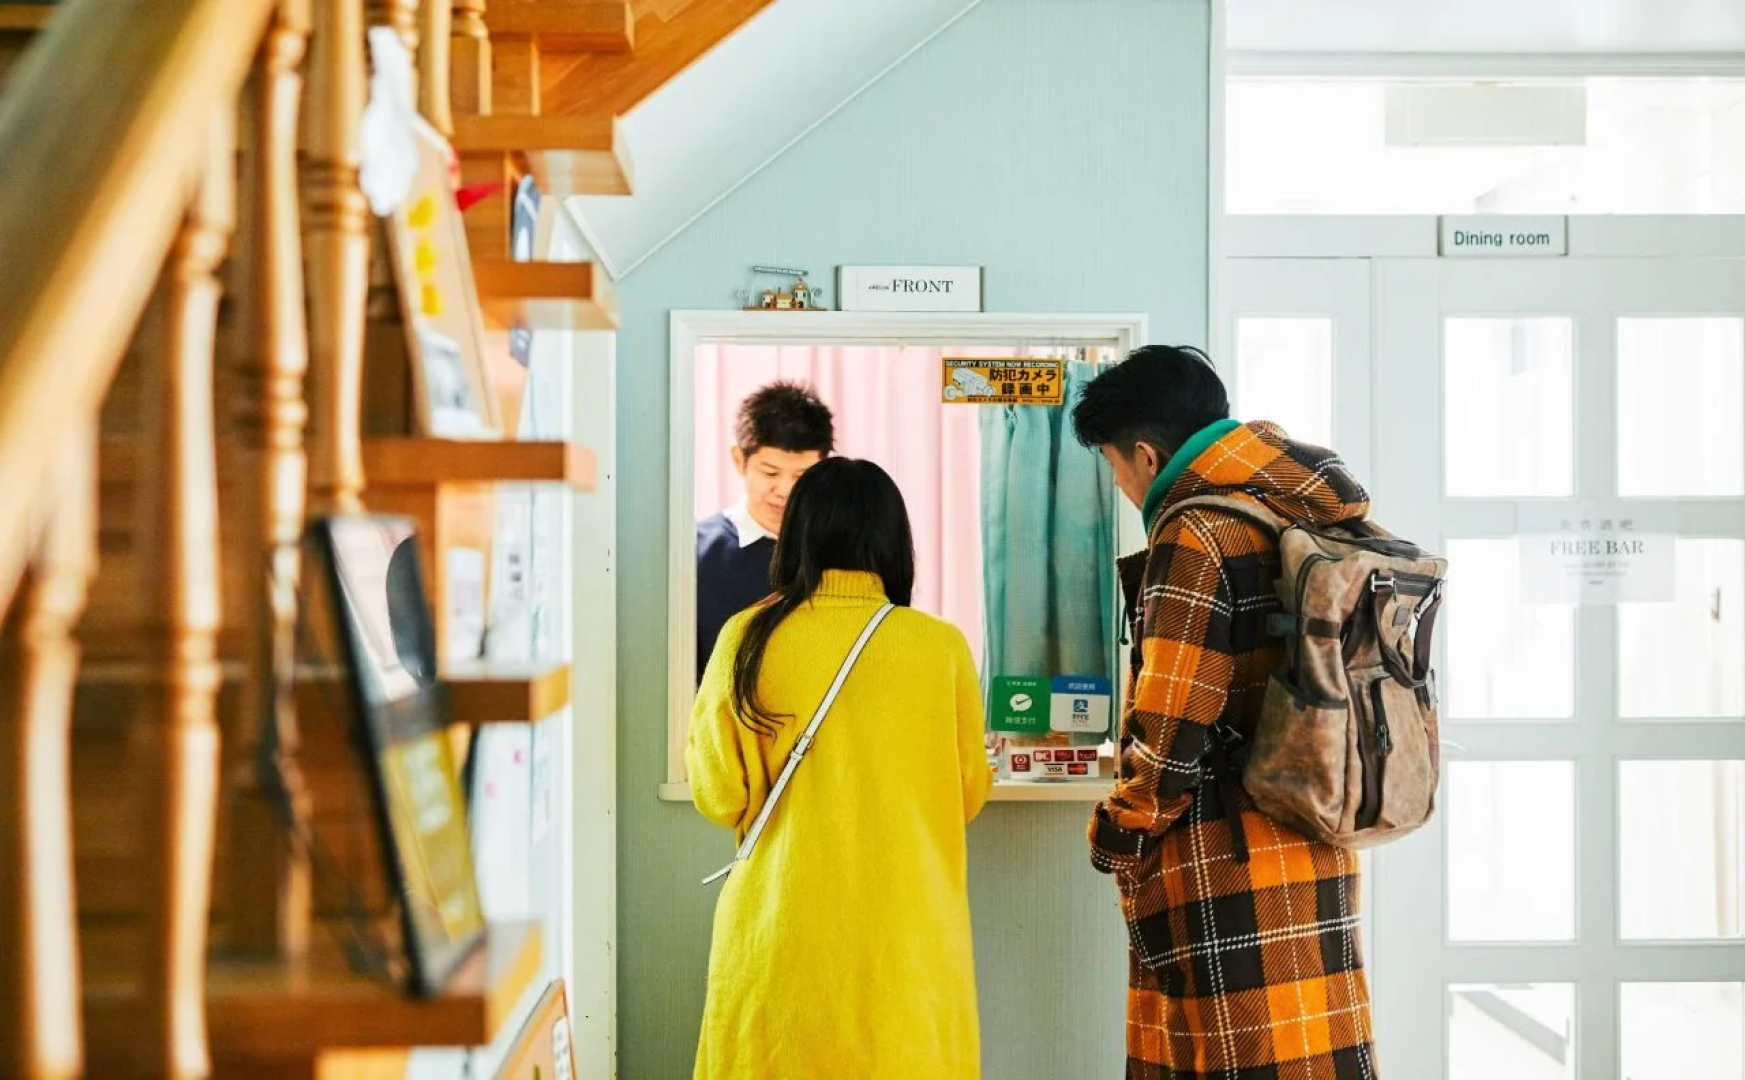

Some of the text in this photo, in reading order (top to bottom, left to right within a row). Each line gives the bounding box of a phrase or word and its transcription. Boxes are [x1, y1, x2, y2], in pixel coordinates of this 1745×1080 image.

[1454, 230, 1550, 247] Dining room
[892, 278, 954, 293] FRONT
[989, 368, 1057, 381] 防犯カメラ
[1550, 539, 1645, 556] FREE BAR
